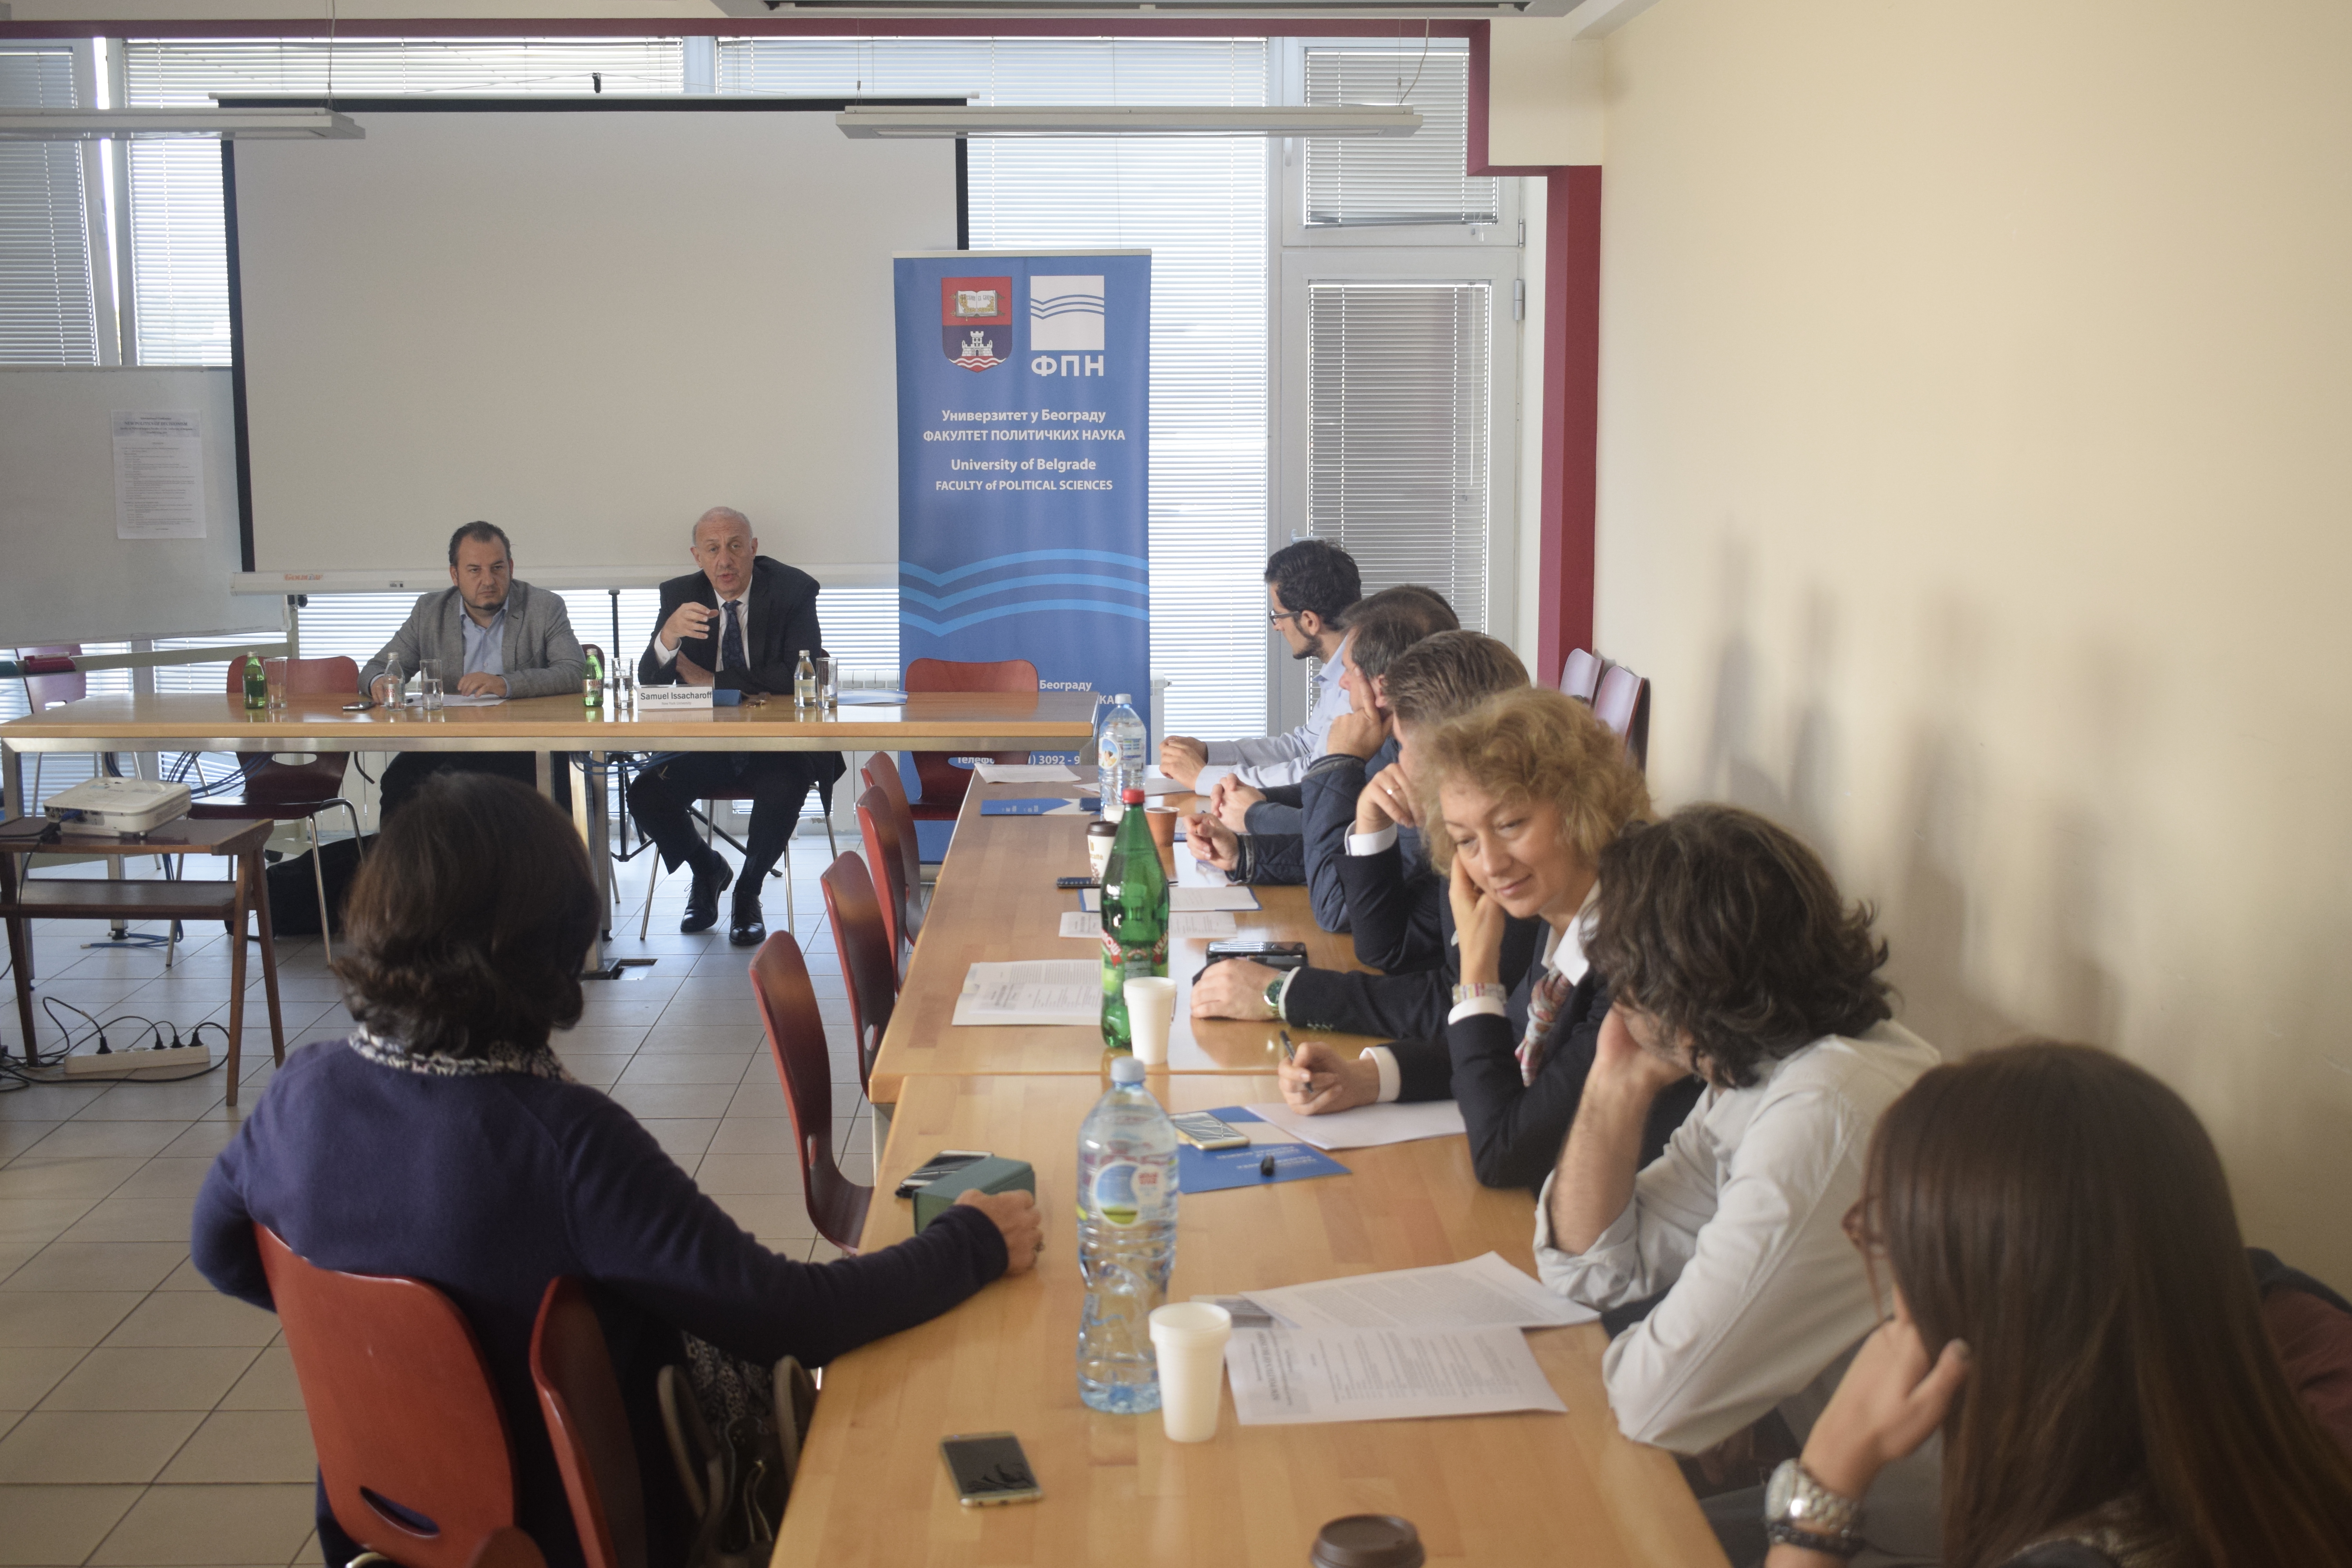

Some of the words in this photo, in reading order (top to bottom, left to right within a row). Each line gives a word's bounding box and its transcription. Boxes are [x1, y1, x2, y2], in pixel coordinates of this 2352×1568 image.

[1031, 355, 1104, 377] ФПН
[942, 410, 1028, 424] Универзитет
[1031, 412, 1038, 423] у
[1042, 409, 1106, 423] Београду
[923, 430, 988, 441] ФАКУЛТЕТ
[991, 430, 1079, 441] ПОЛИТИЧКИХ
[1082, 430, 1125, 440] НАУКА
[951, 458, 1018, 473] University
[1020, 458, 1034, 470] of
[1037, 458, 1096, 473] Belgrade
[936, 481, 983, 491] FACULTY
[985, 480, 997, 490] of
[999, 480, 1057, 490] POLITICAL
[1059, 480, 1113, 490] SCIENCES
[1040, 680, 1092, 691] Београду
[671, 691, 712, 699] Issacharoff
[1039, 755, 1065, 764] 3092
